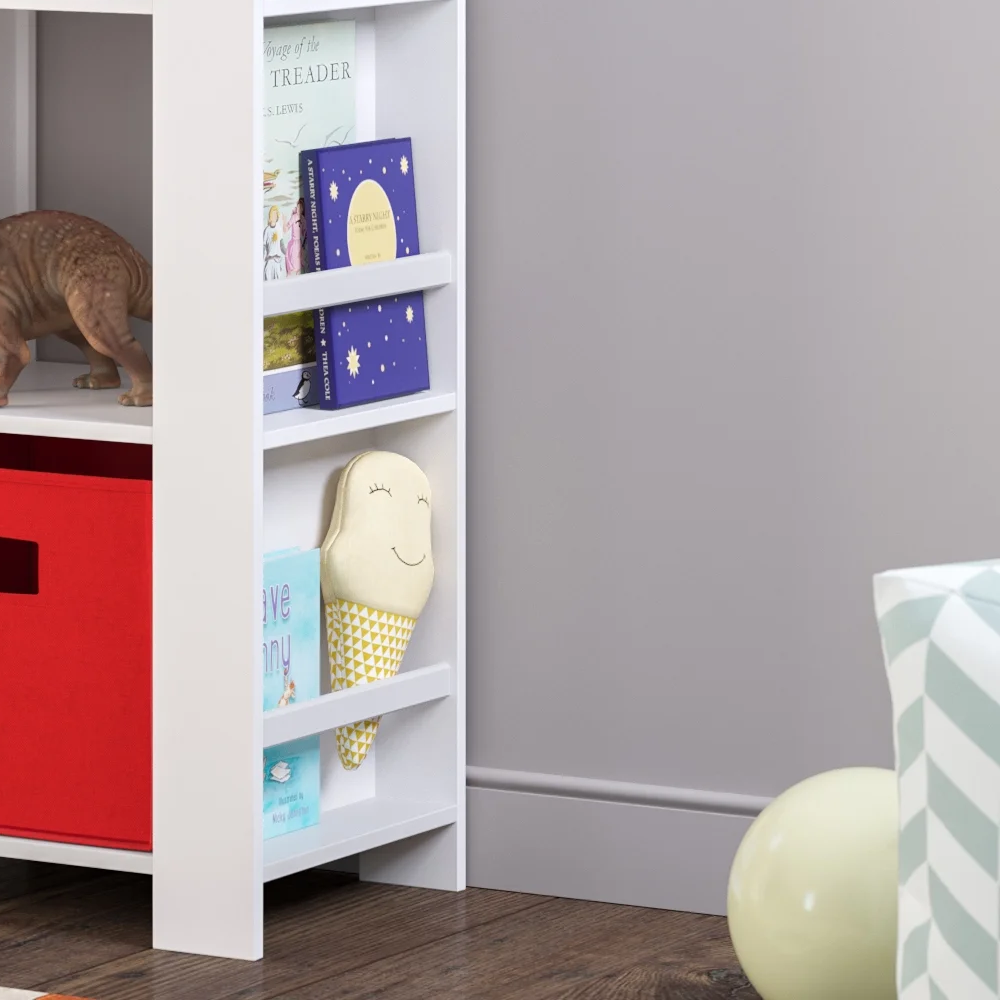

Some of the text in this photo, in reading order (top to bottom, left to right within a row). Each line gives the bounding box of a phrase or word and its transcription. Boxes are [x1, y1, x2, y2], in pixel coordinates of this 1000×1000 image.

[294, 36, 307, 59] of
[307, 35, 320, 53] the
[270, 61, 351, 87] TREADER
[276, 102, 304, 116] LEWIS
[307, 158, 313, 166] A
[307, 166, 317, 201] STARRY
[312, 235, 322, 266] POEMS
[321, 351, 329, 379] THEA
[323, 379, 331, 401] COLE
